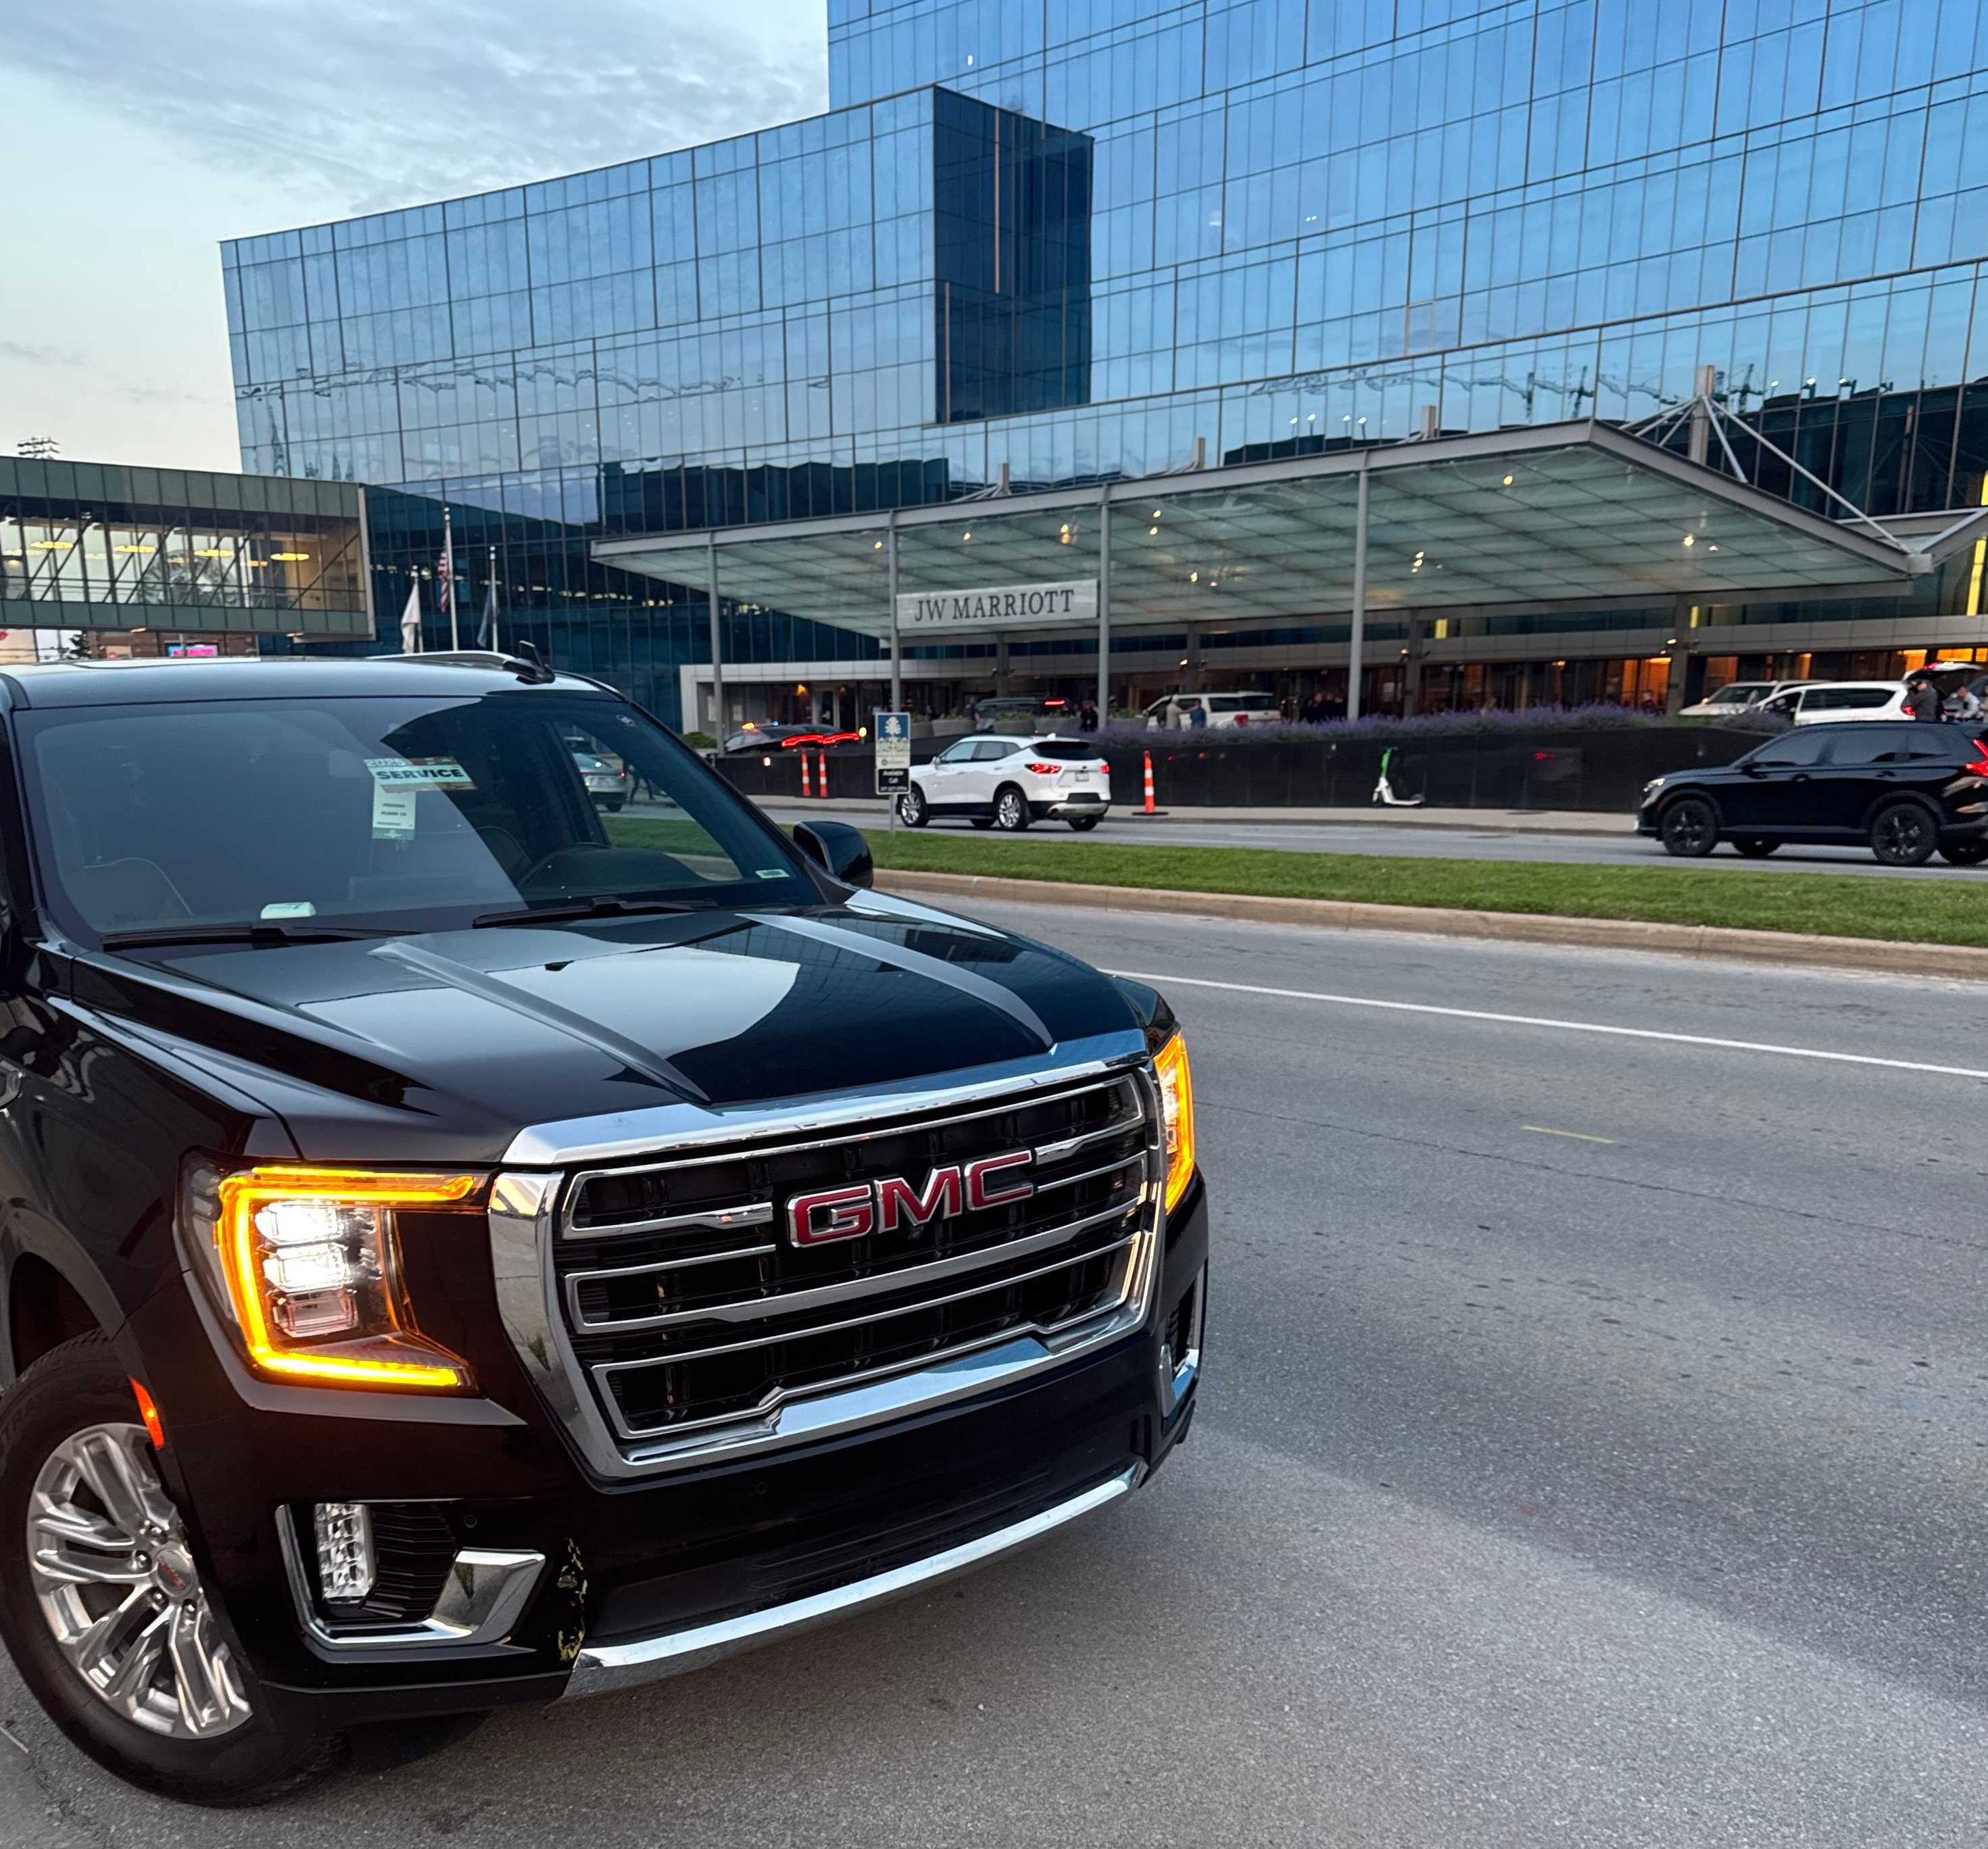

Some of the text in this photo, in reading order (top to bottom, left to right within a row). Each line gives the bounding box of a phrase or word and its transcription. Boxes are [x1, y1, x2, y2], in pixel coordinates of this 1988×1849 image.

[915, 590, 1074, 622] JW MARRIOTT
[376, 769, 464, 780] SERVICE
[787, 1149, 1034, 1249] GMC
